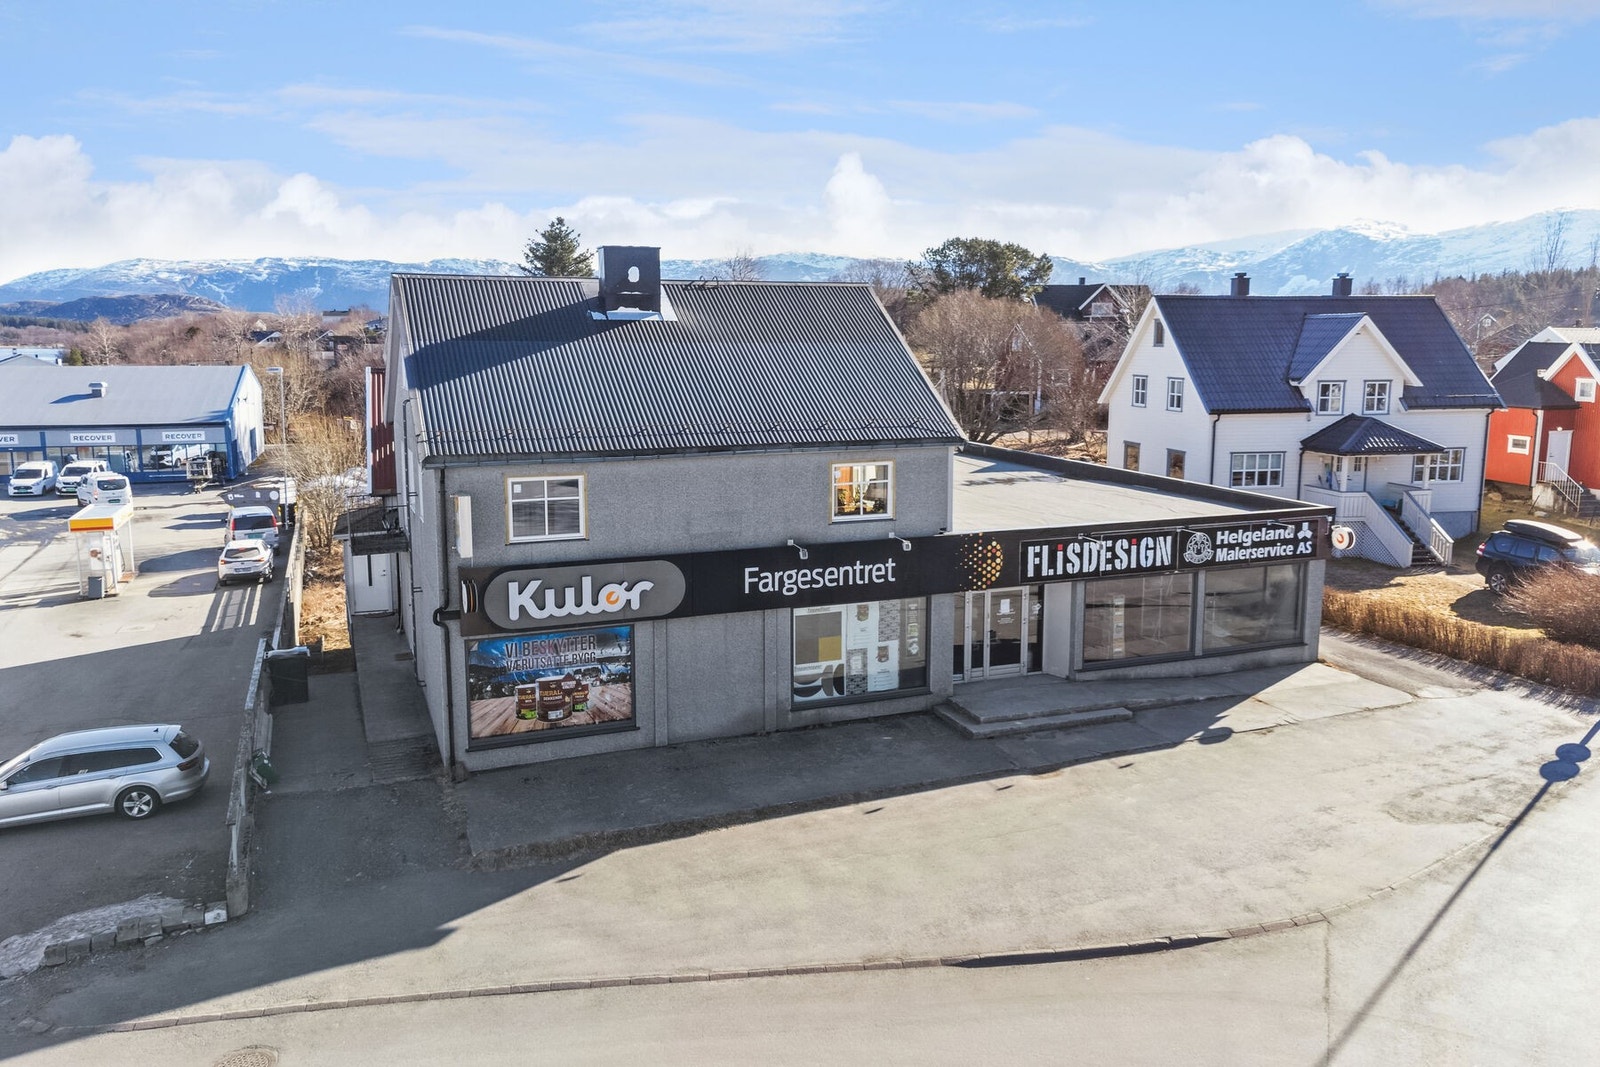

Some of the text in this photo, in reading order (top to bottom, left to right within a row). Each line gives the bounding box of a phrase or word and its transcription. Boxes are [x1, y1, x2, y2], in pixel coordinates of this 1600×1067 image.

[72, 434, 113, 442] RECOVER
[164, 432, 202, 440] RECOVER
[1215, 525, 1295, 546] Helgeland
[1215, 545, 1294, 562] Malerservice
[1296, 541, 1313, 554] AS
[744, 558, 896, 596] Fargesentret
[507, 575, 655, 622] Kulør
[505, 635, 596, 659] VI BESKYTTER
[506, 651, 596, 672] VÆRUTSATTE BYGG
